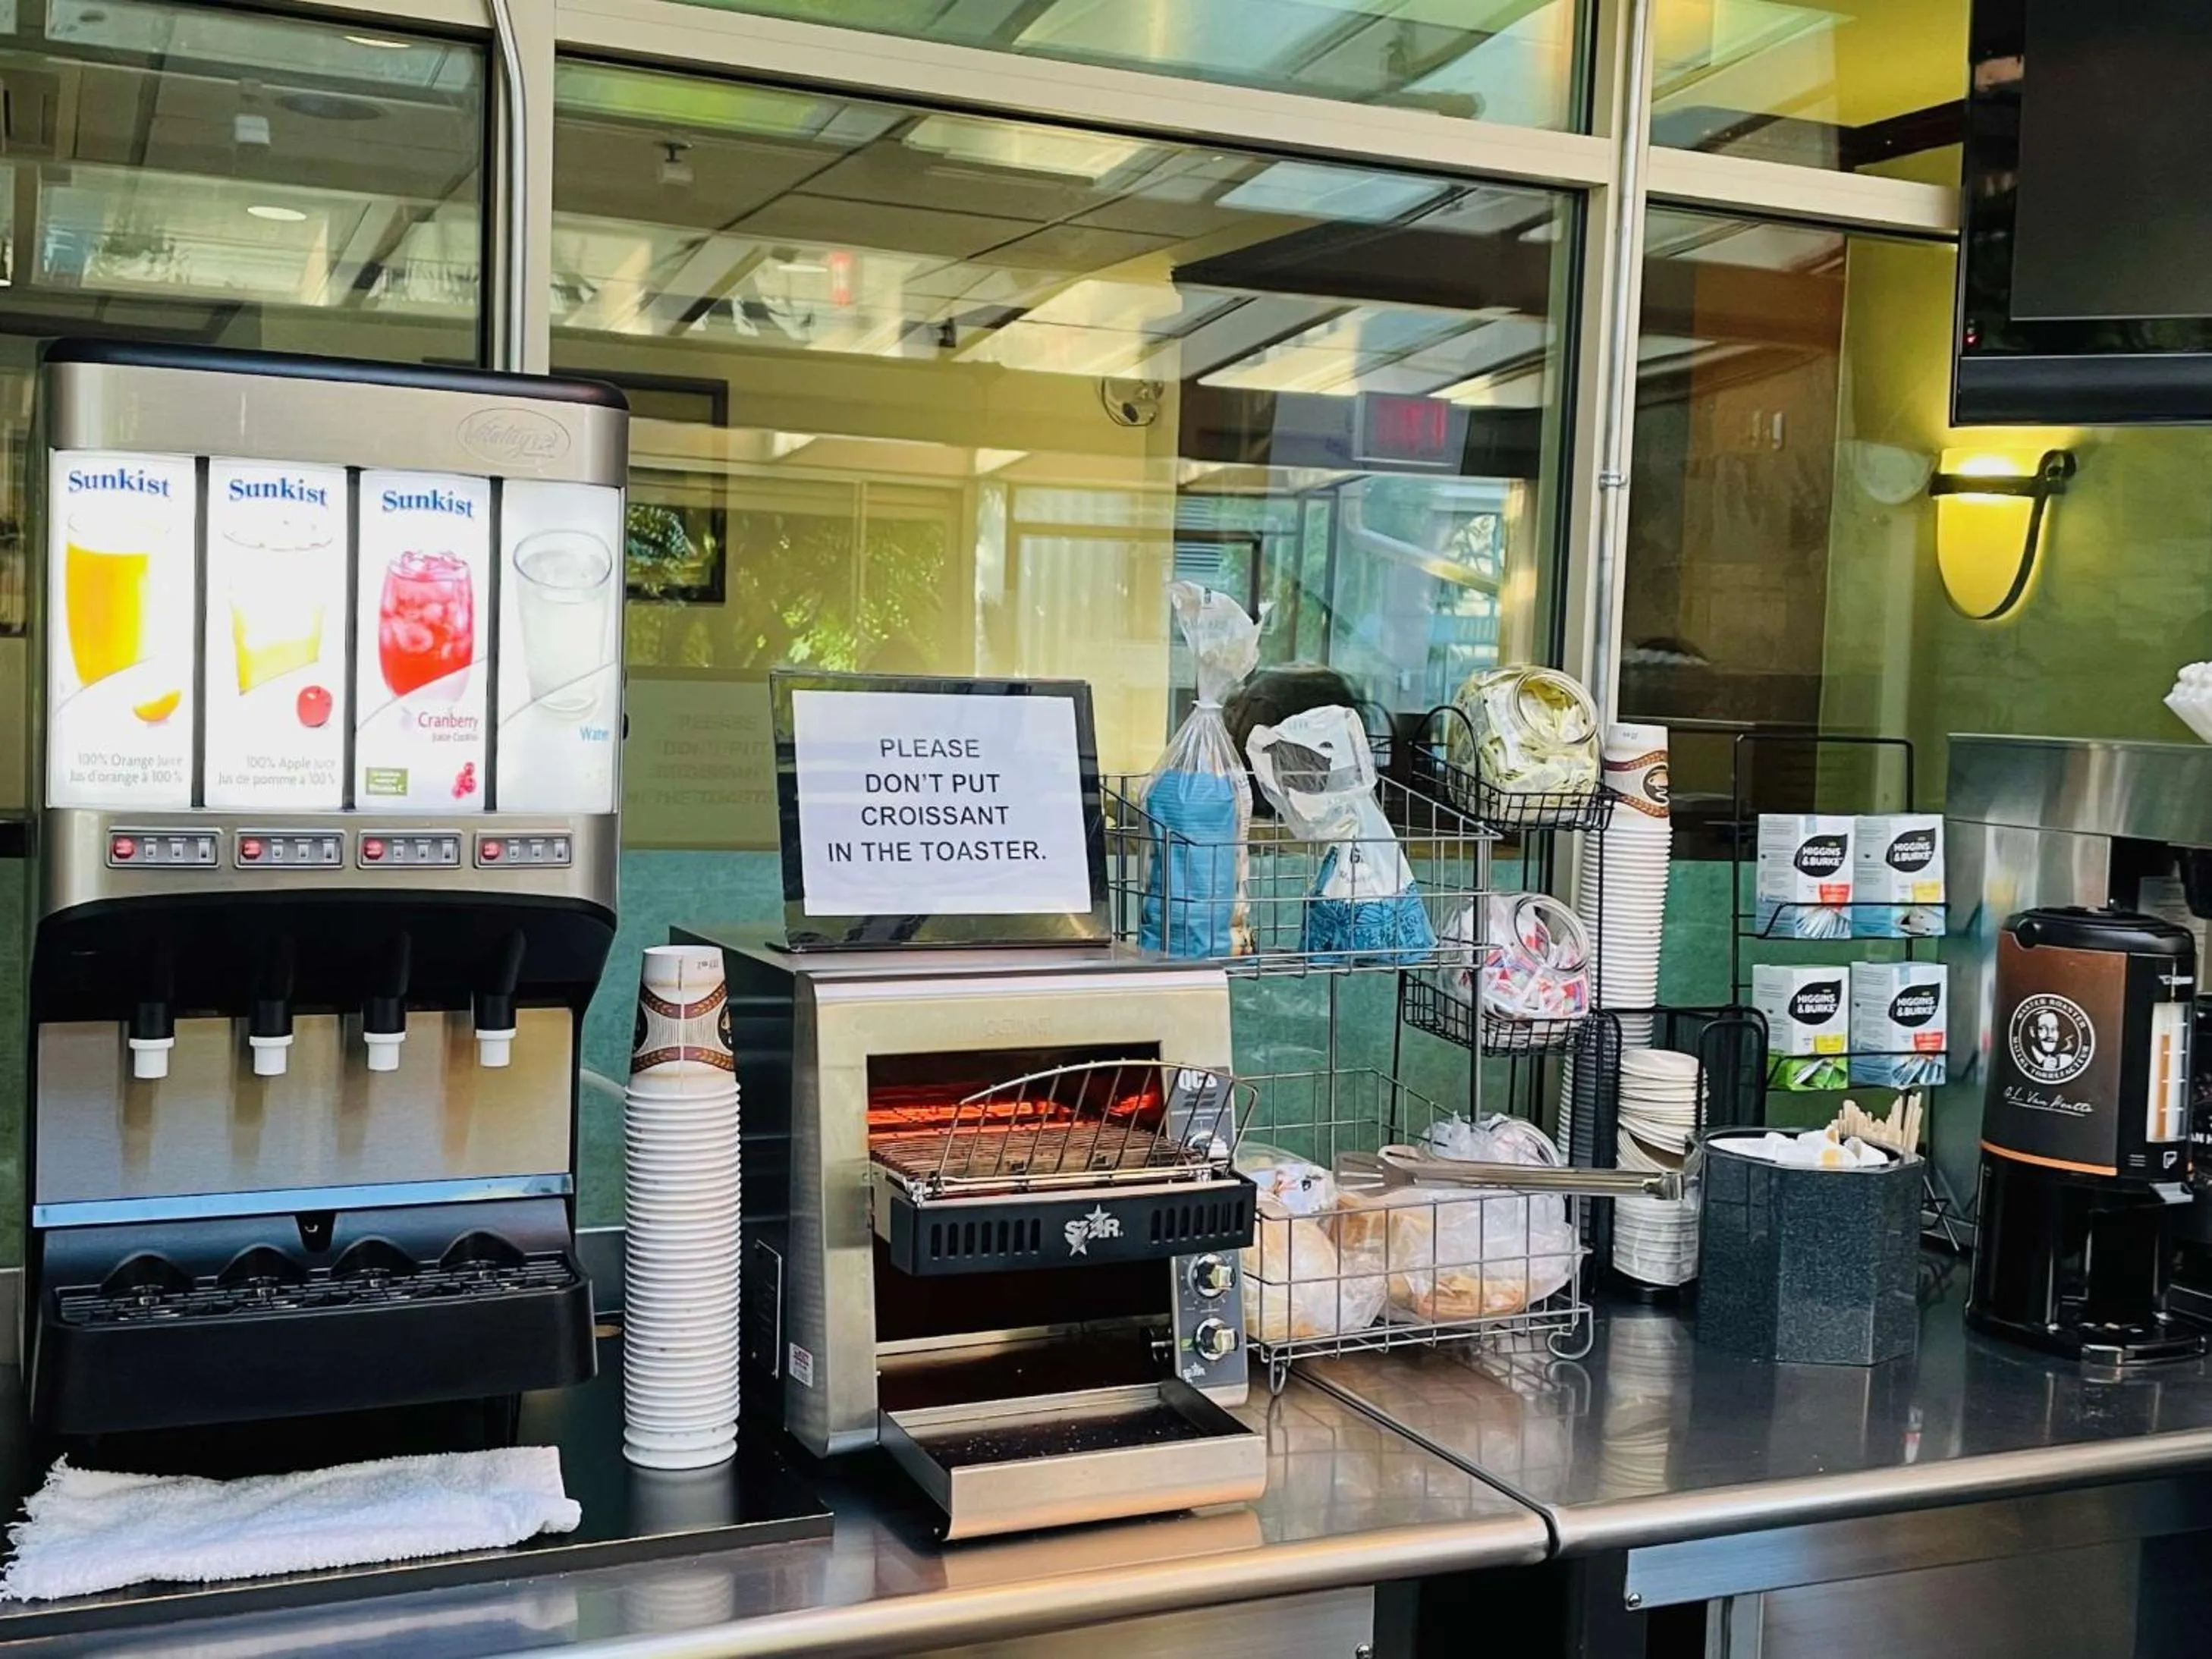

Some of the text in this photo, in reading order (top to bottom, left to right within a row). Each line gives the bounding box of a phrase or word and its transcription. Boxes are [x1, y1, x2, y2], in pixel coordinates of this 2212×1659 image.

[68, 469, 171, 498] Sunkist
[229, 477, 328, 506] Sunkist
[382, 489, 474, 519] Sunkist
[418, 711, 479, 731] Cranberry
[880, 738, 981, 758] PLEASE
[111, 752, 154, 769] Orange
[865, 773, 1001, 793] DON'T PUT
[860, 806, 1010, 826] CROISSANT
[828, 840, 1048, 862] IN THE TOASTER.
[1802, 846, 1842, 856] HIGGINS
[1893, 840, 1931, 852] HIGGINS
[1797, 994, 1837, 1004] HIGGINS
[1896, 996, 1936, 1007] HIGGINS
